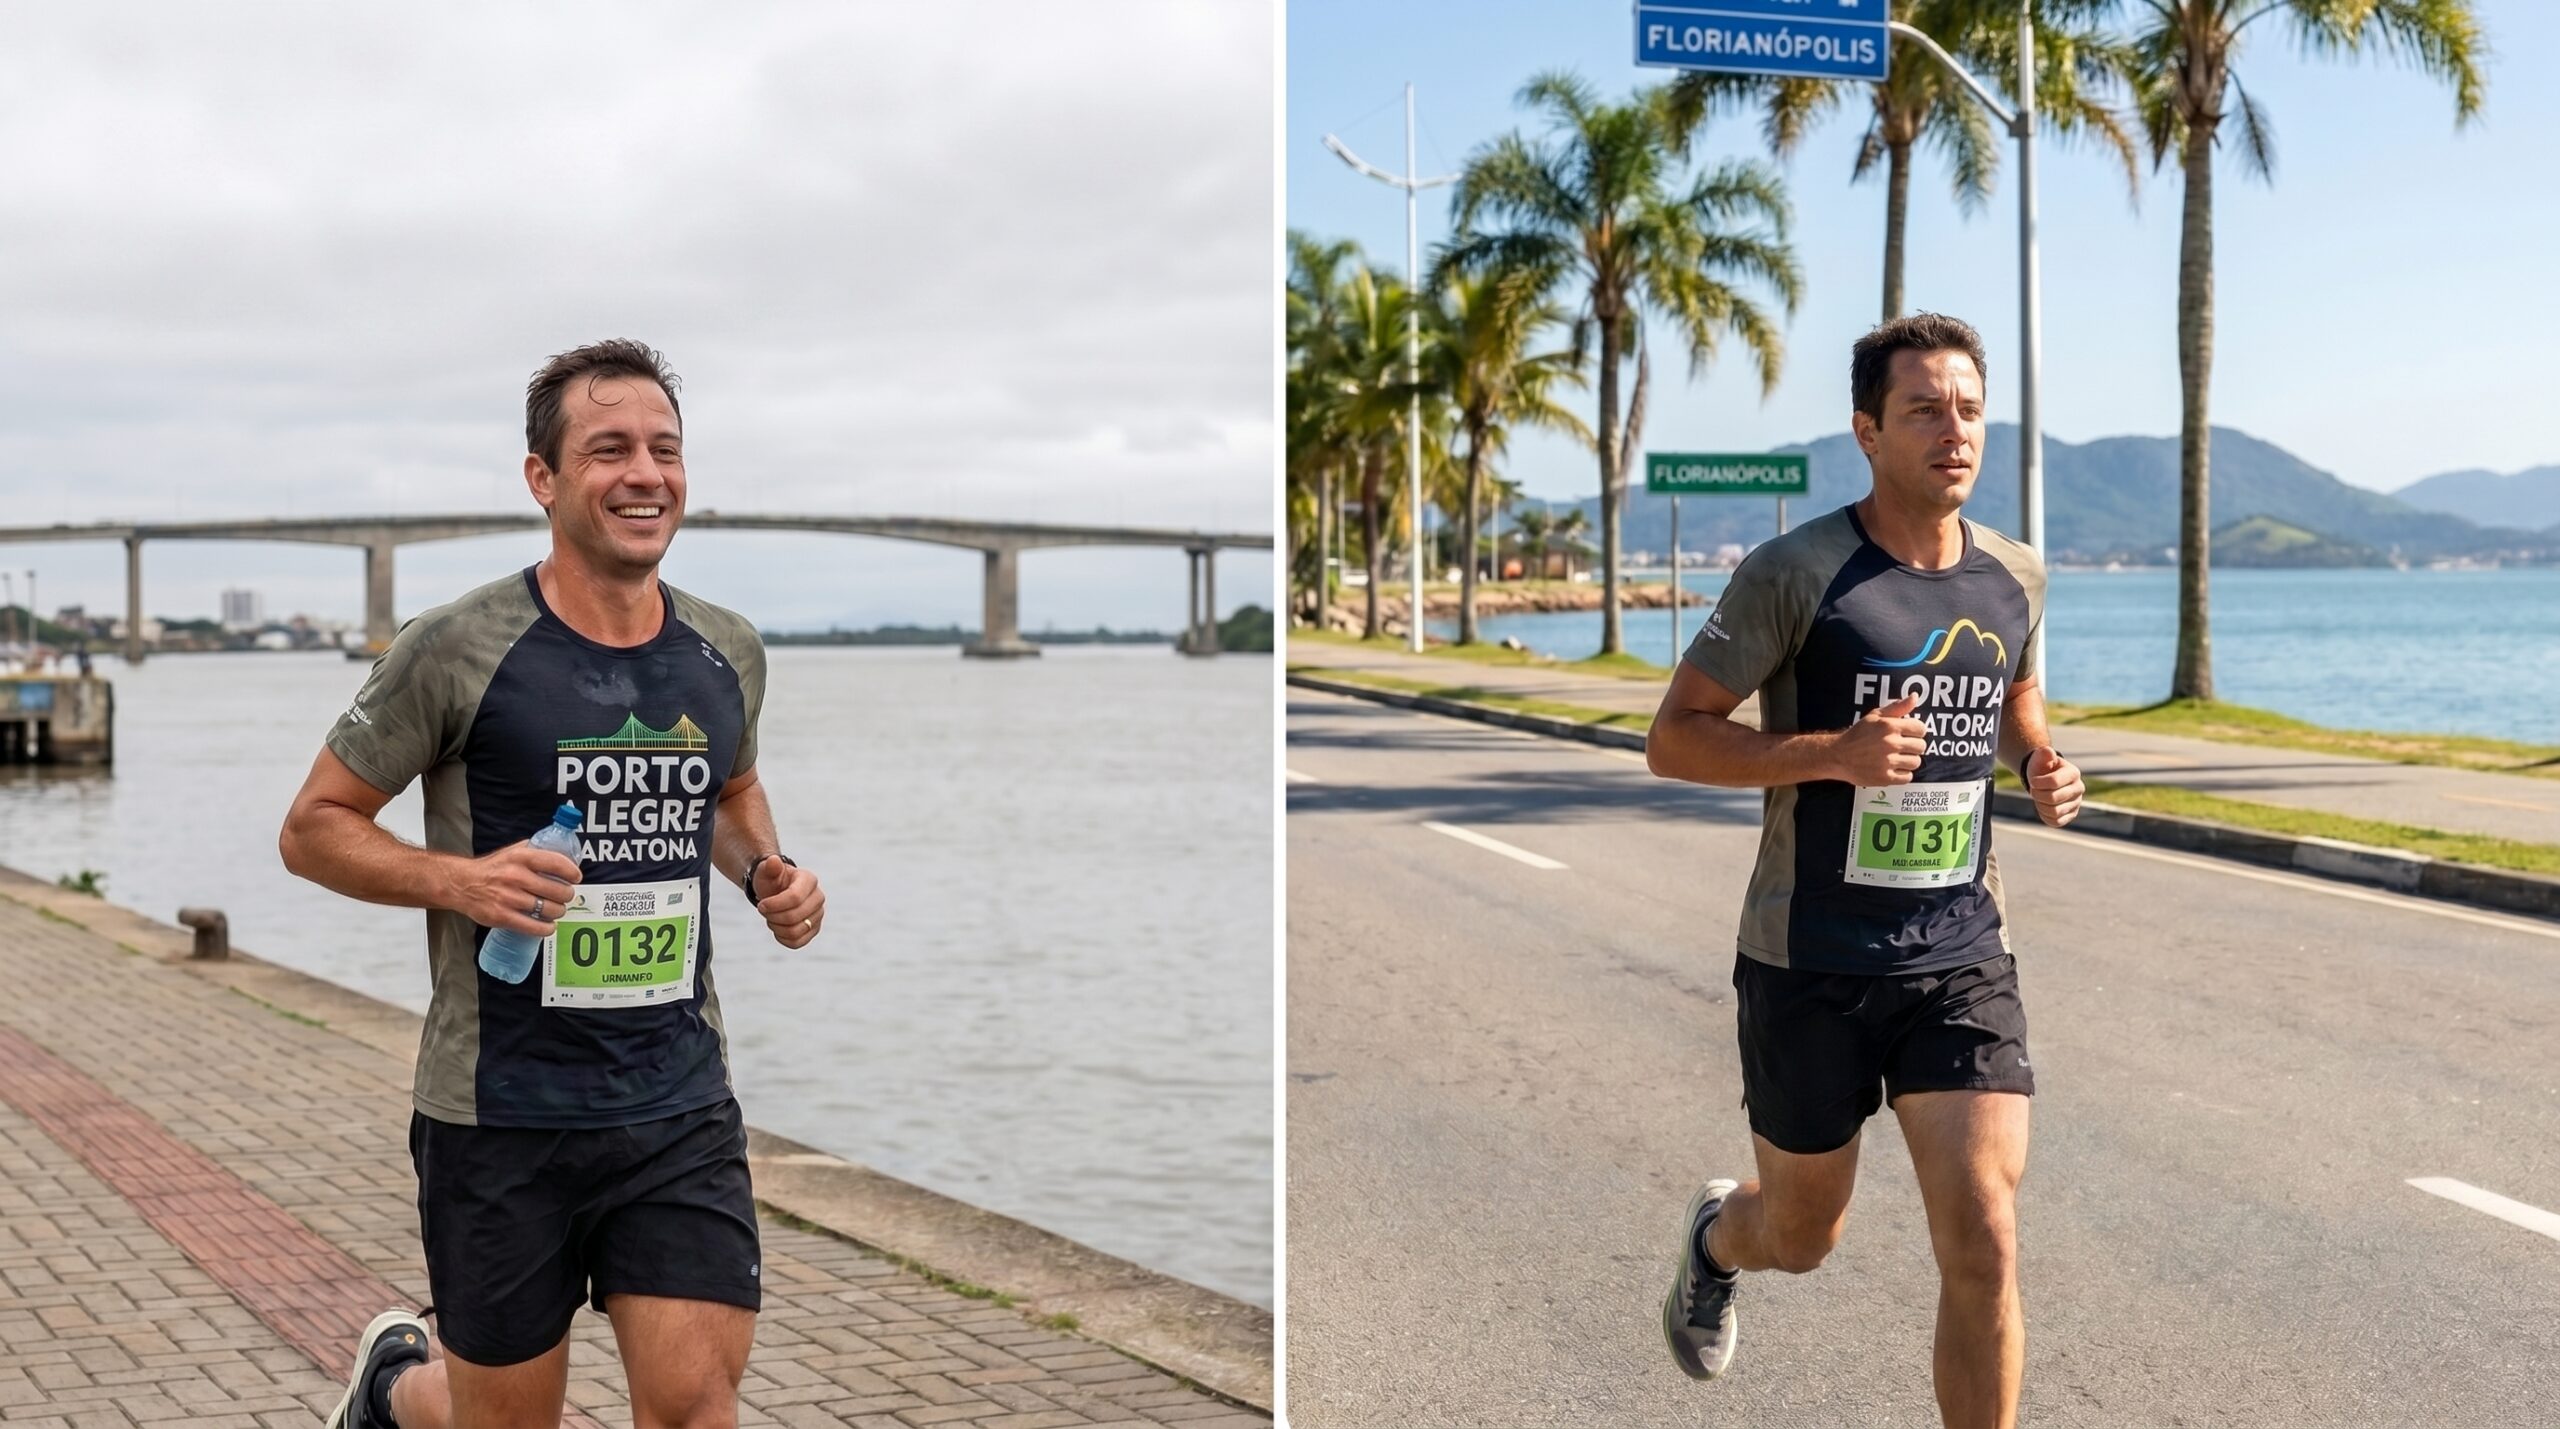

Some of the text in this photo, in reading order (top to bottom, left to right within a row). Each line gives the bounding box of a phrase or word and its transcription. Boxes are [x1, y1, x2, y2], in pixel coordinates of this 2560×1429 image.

[1647, 25, 1877, 64] FLORIANÓPOLIS
[1654, 462, 1802, 484] FLORIANÓPOLIS
[1854, 673, 2005, 708] FLORIPA
[1853, 711, 1995, 737] ATORA
[557, 755, 711, 795] PORTO
[580, 836, 698, 862] ARATONA
[1871, 818, 1959, 854] 0131
[571, 923, 677, 968] 0132
